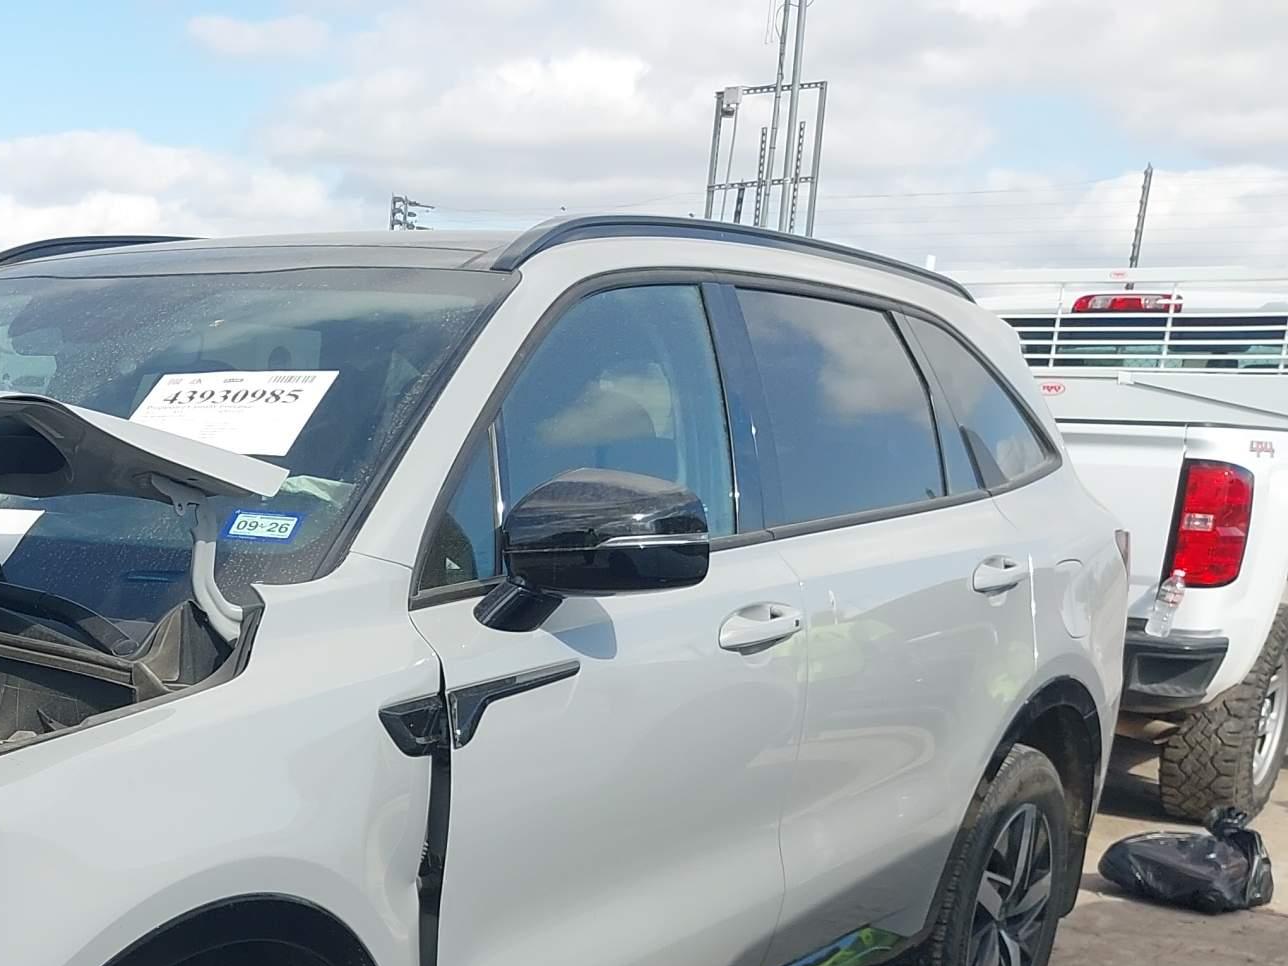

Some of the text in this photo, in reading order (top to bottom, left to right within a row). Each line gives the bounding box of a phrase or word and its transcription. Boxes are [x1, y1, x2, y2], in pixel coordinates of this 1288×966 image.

[163, 388, 305, 405] 43930985
[236, 520, 290, 534] 09 26
